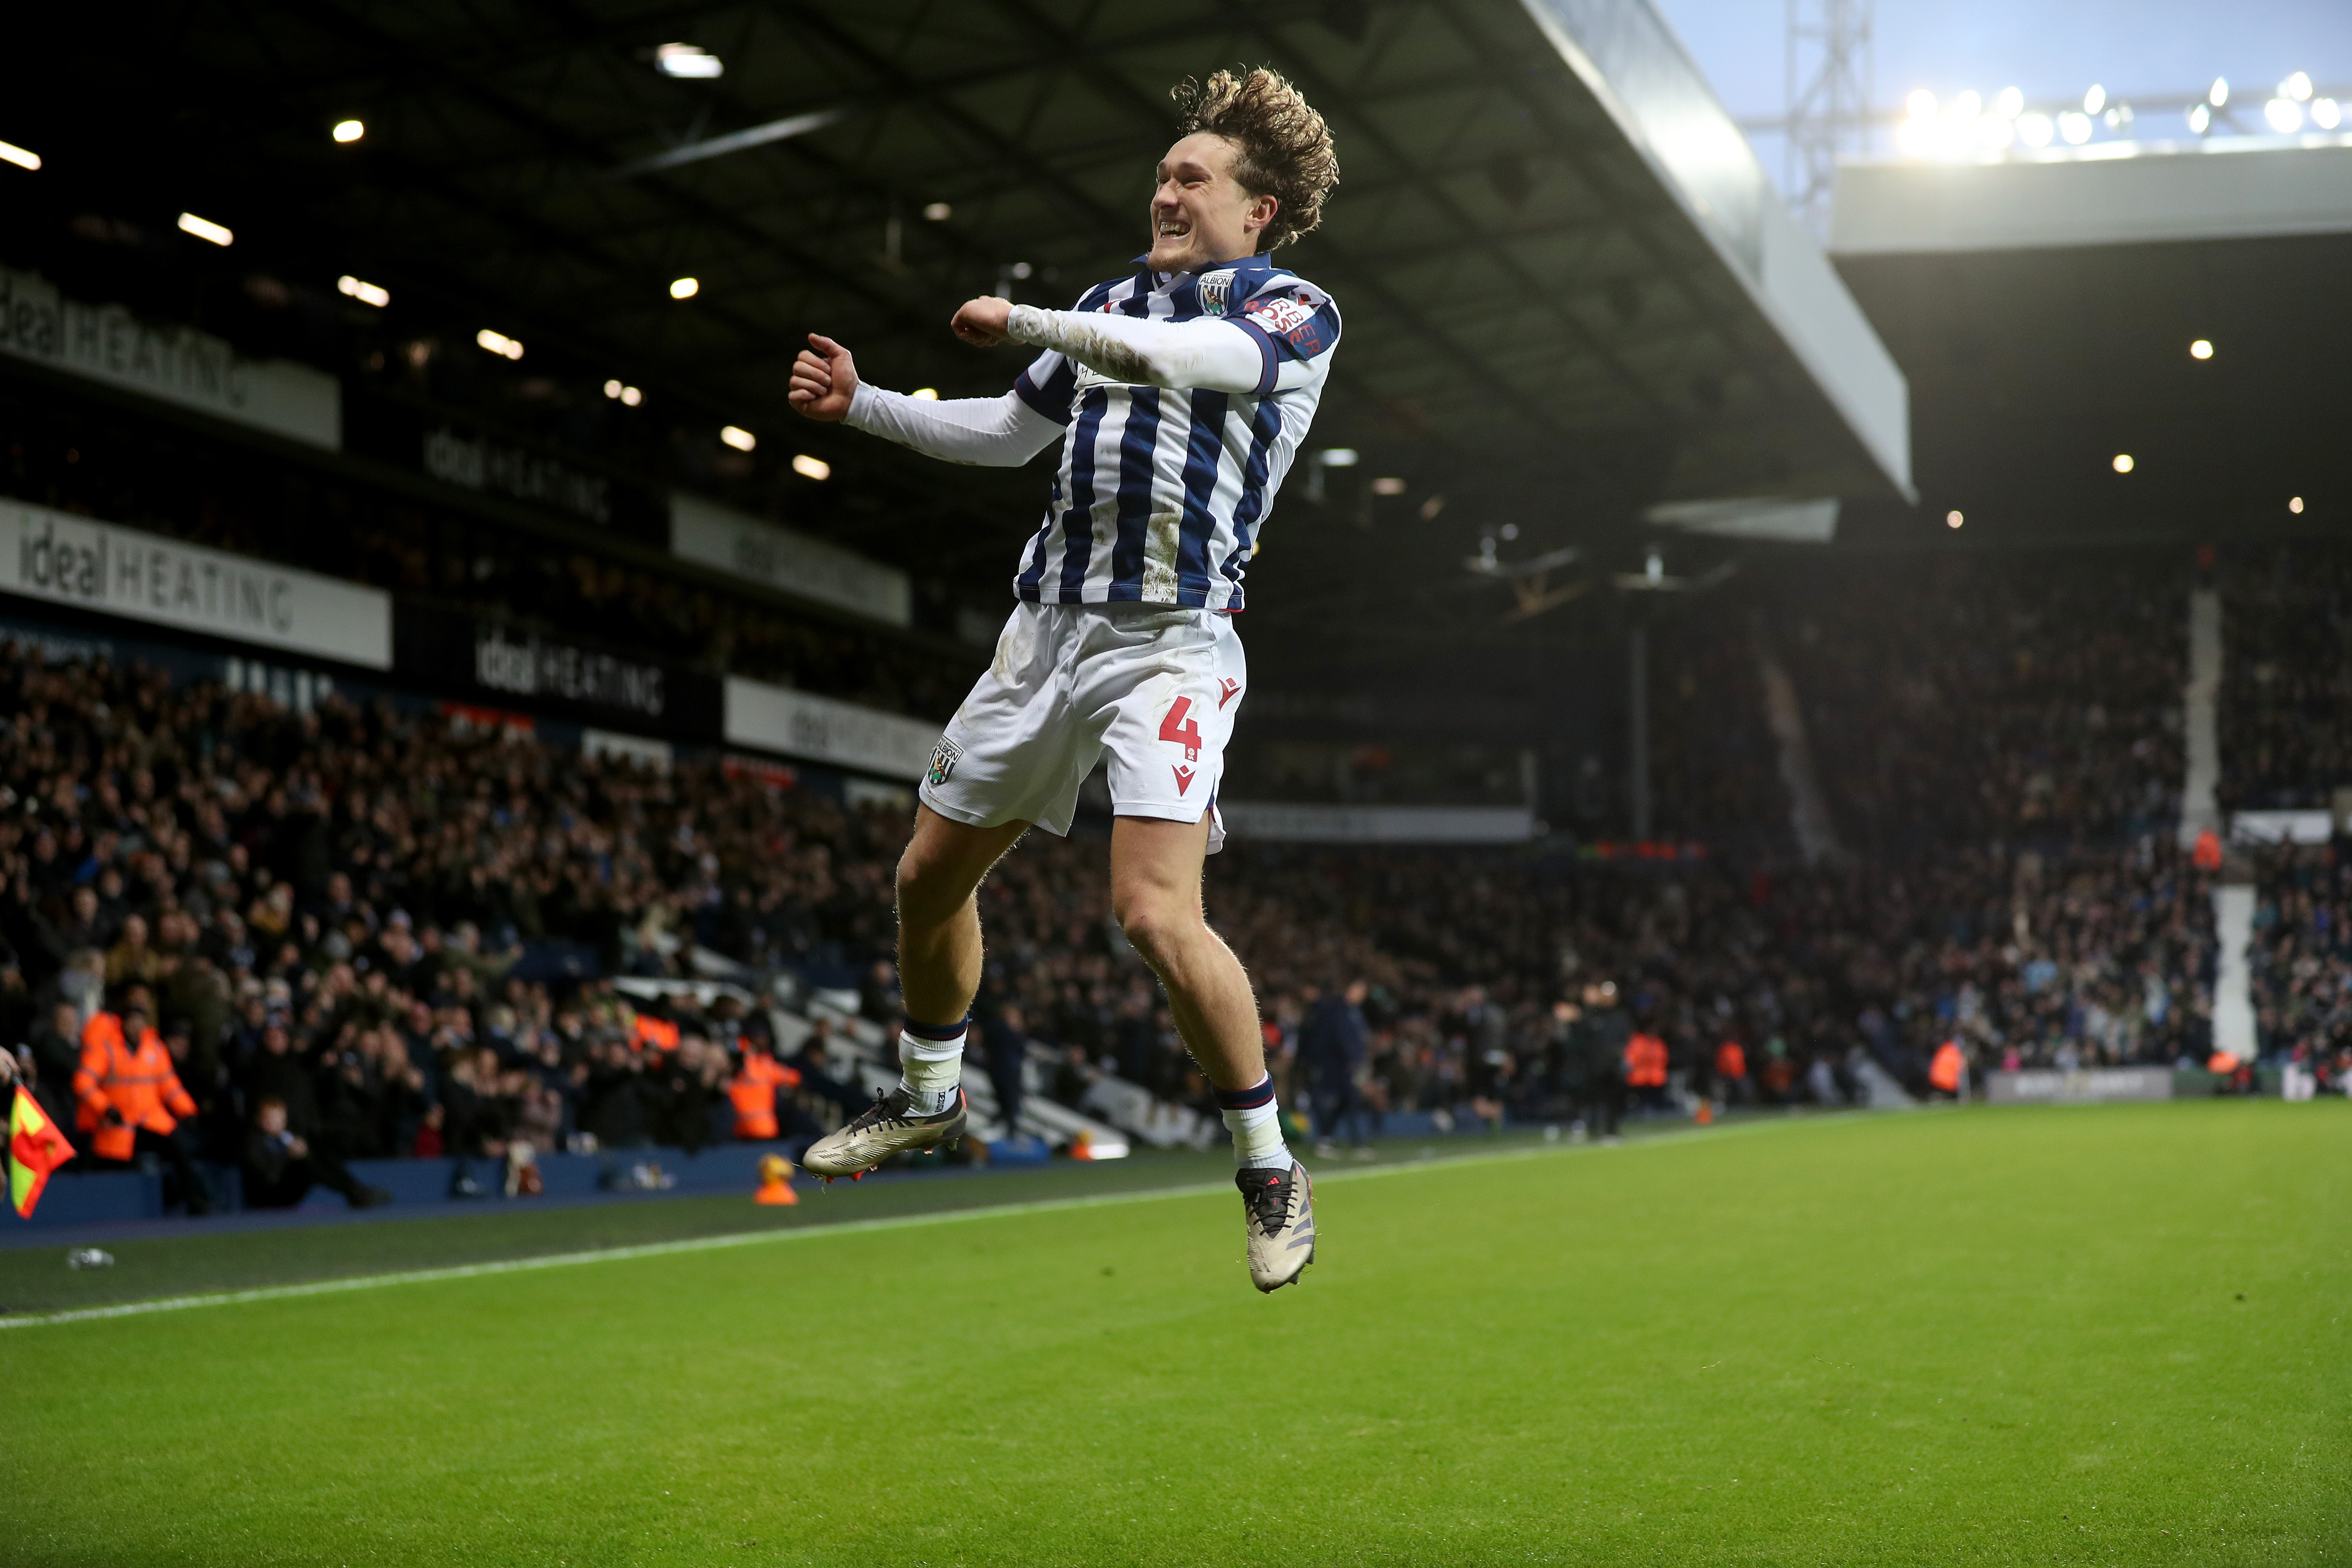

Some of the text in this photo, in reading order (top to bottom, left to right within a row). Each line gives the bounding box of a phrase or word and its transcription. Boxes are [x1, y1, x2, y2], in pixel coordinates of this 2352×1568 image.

[1200, 277, 1230, 285] ALBION
[19, 510, 294, 634] ideal HEATING
[1159, 695, 1202, 762] 4
[937, 741, 959, 761] ALBION
